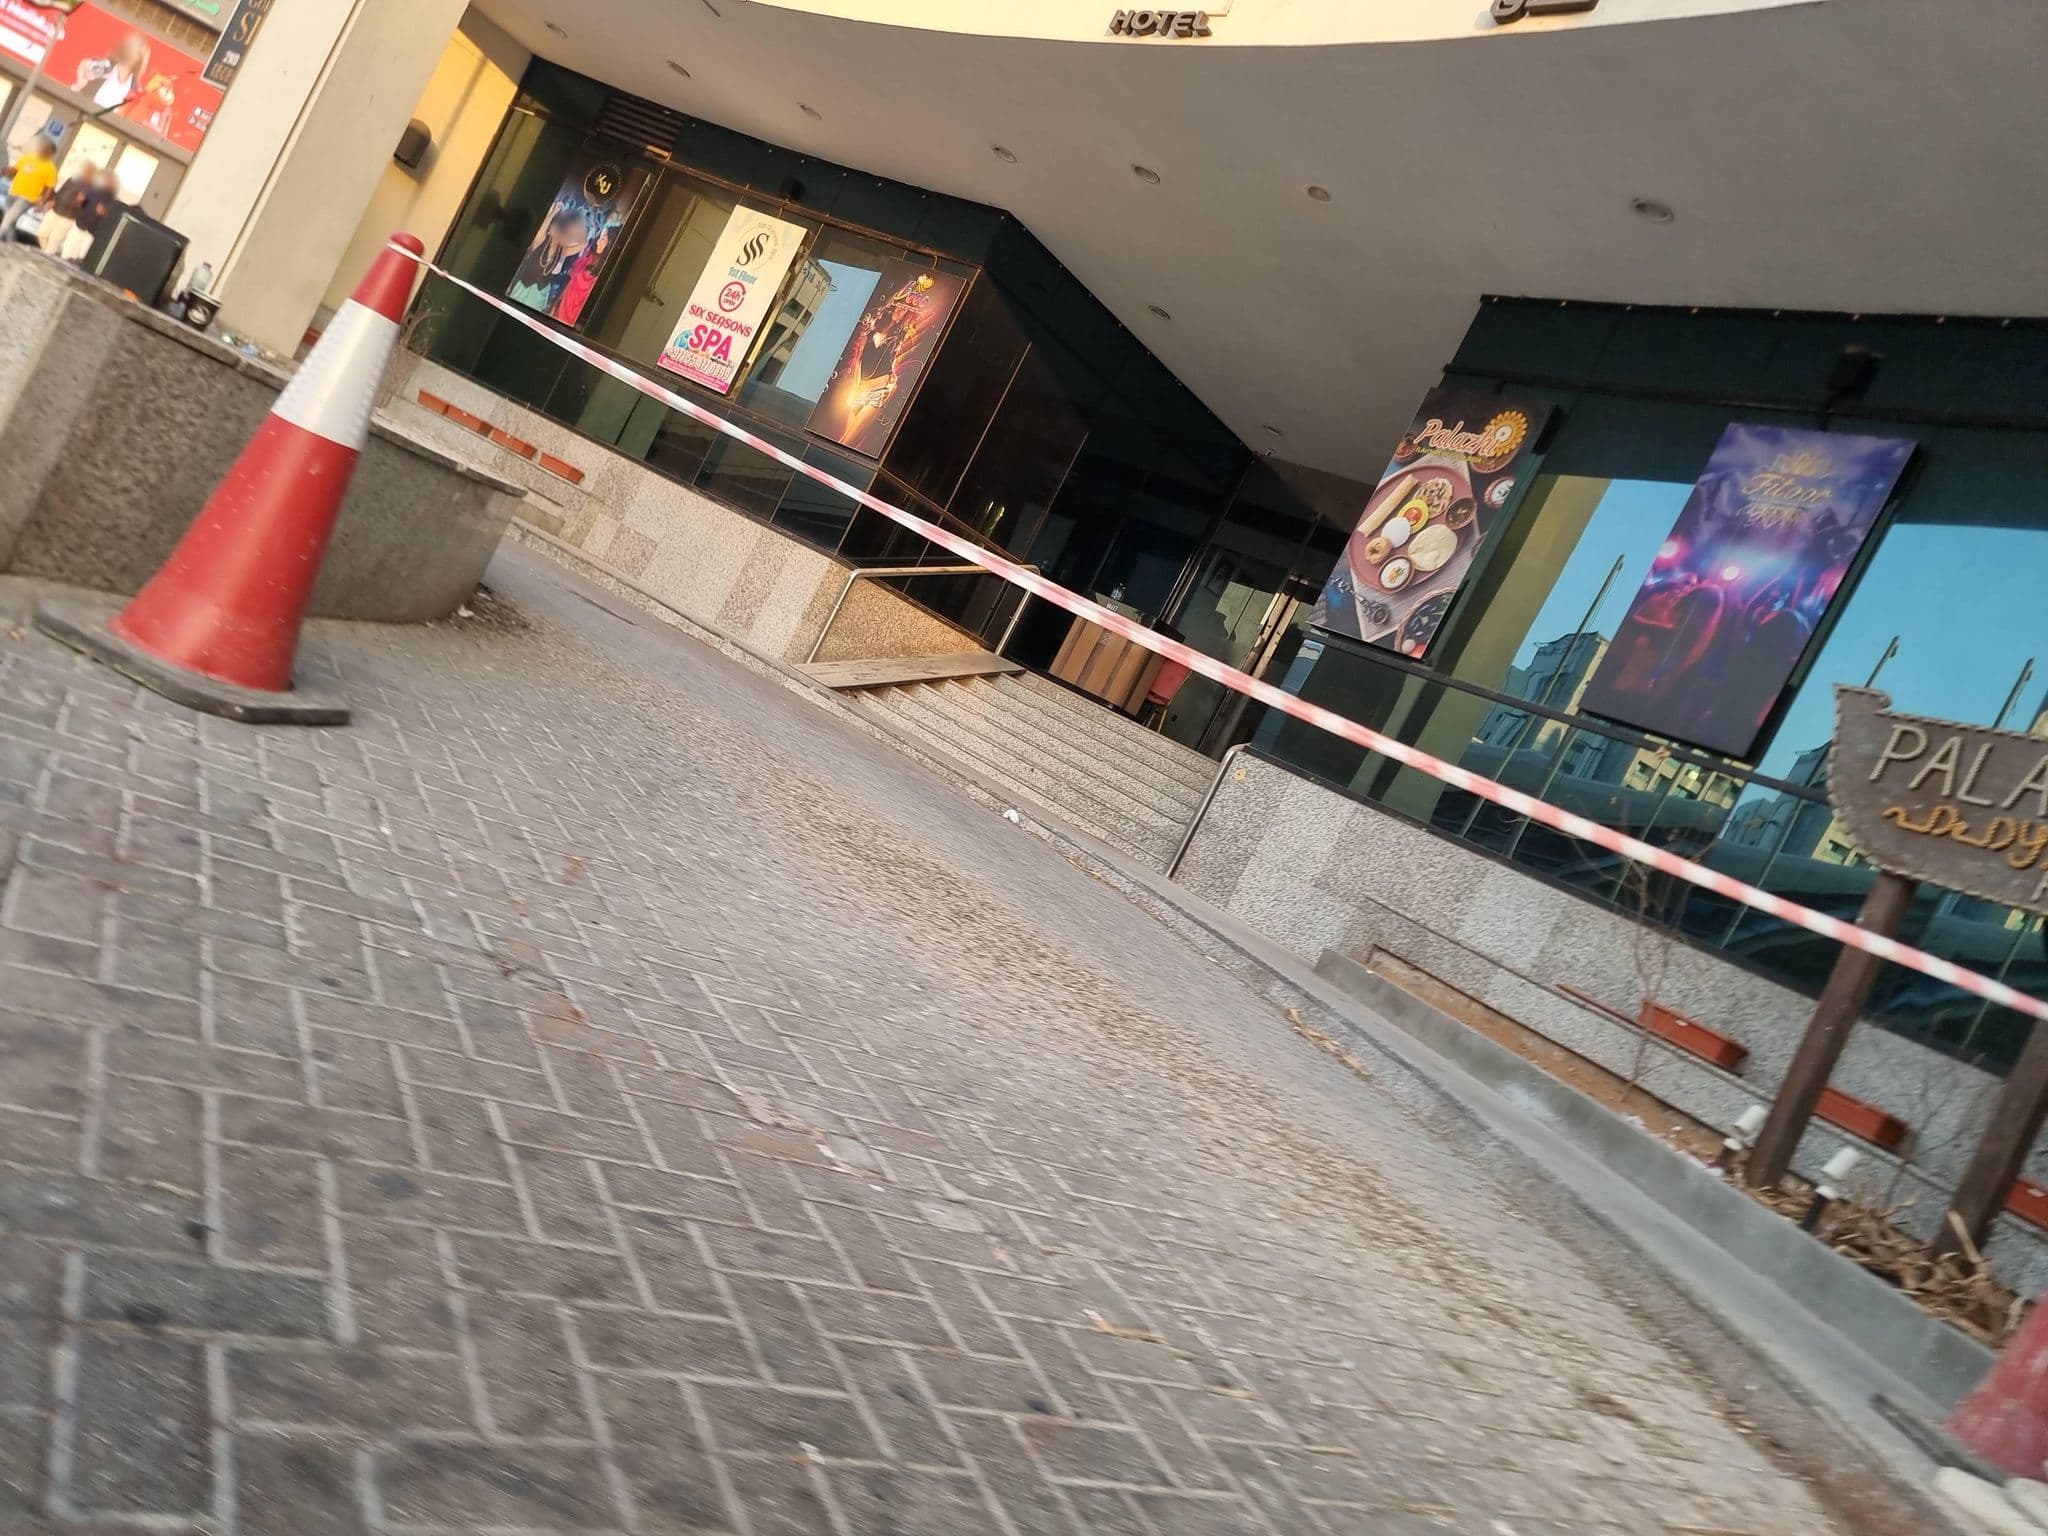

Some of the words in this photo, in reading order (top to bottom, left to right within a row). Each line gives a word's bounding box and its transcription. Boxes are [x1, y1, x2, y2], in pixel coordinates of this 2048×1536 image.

[1109, 9, 1211, 37] HOTEL
[724, 288, 741, 300] 24h
[689, 304, 706, 318] SIX
[706, 311, 752, 337] SEASONS
[688, 324, 733, 361] SPA
[1413, 419, 1498, 456] Palazhi
